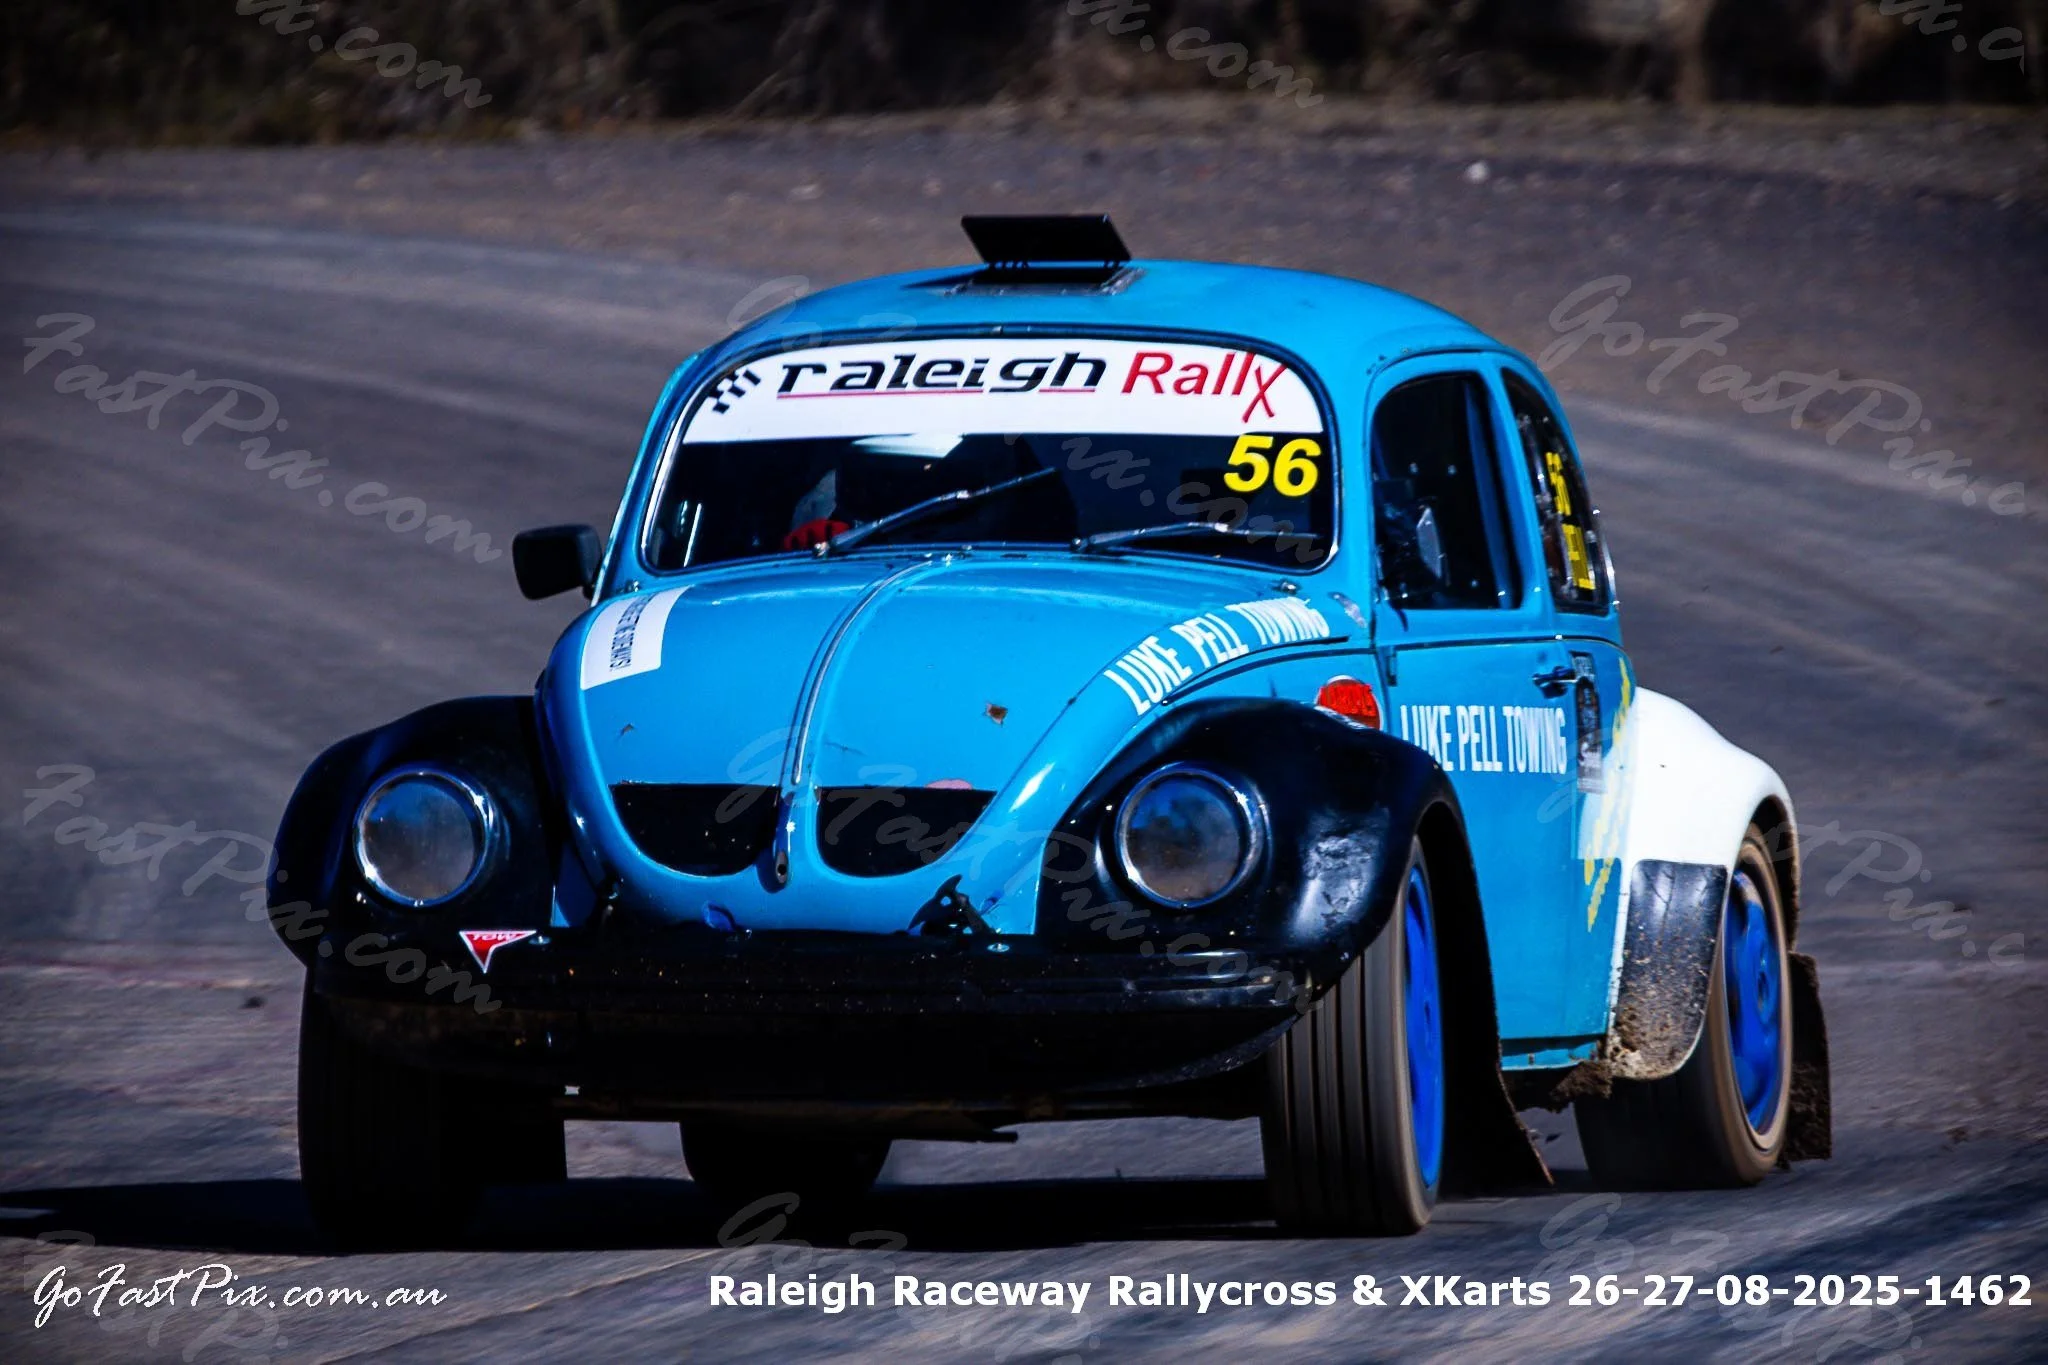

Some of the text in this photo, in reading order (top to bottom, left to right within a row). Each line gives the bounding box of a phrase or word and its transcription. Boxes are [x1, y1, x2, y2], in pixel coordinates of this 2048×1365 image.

[777, 349, 1107, 394] raleigh
[1223, 433, 1322, 497] 56
[1103, 635, 1193, 716] LUKE
[1169, 612, 1249, 669] PELL
[1455, 704, 1503, 772] PELL
[1502, 705, 1568, 775] TOWING
